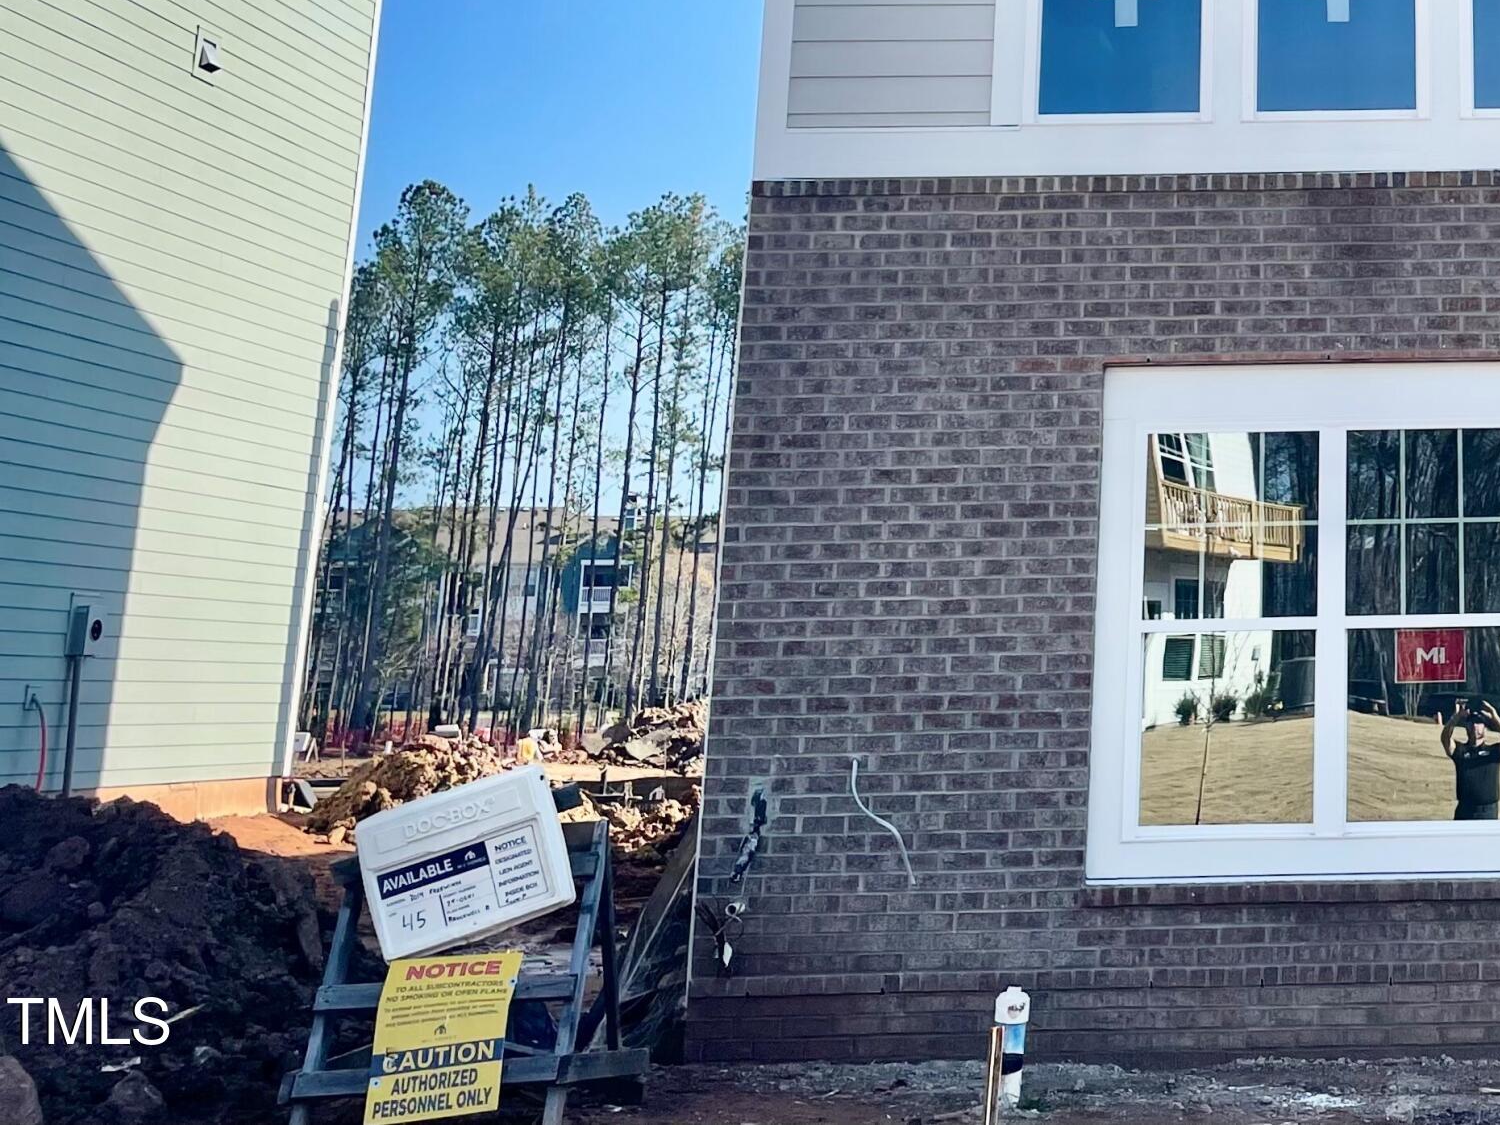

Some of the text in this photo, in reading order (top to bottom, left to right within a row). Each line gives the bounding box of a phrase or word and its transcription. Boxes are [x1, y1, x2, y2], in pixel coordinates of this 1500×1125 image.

[1415, 646, 1446, 665] MI
[494, 835, 527, 852] NOTICE
[382, 858, 454, 894] AVAILABLE
[498, 869, 540, 888] INFORMATION
[402, 909, 427, 932] 45
[405, 960, 503, 981] NOTICE
[396, 980, 504, 994] TO ALL SUBCONTRACTORS
[400, 992, 438, 1002] SMOKING
[441, 990, 453, 998] OR
[455, 989, 479, 997] OPEN
[382, 1039, 496, 1074] CAUTION
[391, 1068, 479, 1096] AUTHORIZED
[372, 1086, 493, 1119] PERSONNEL ONLY
